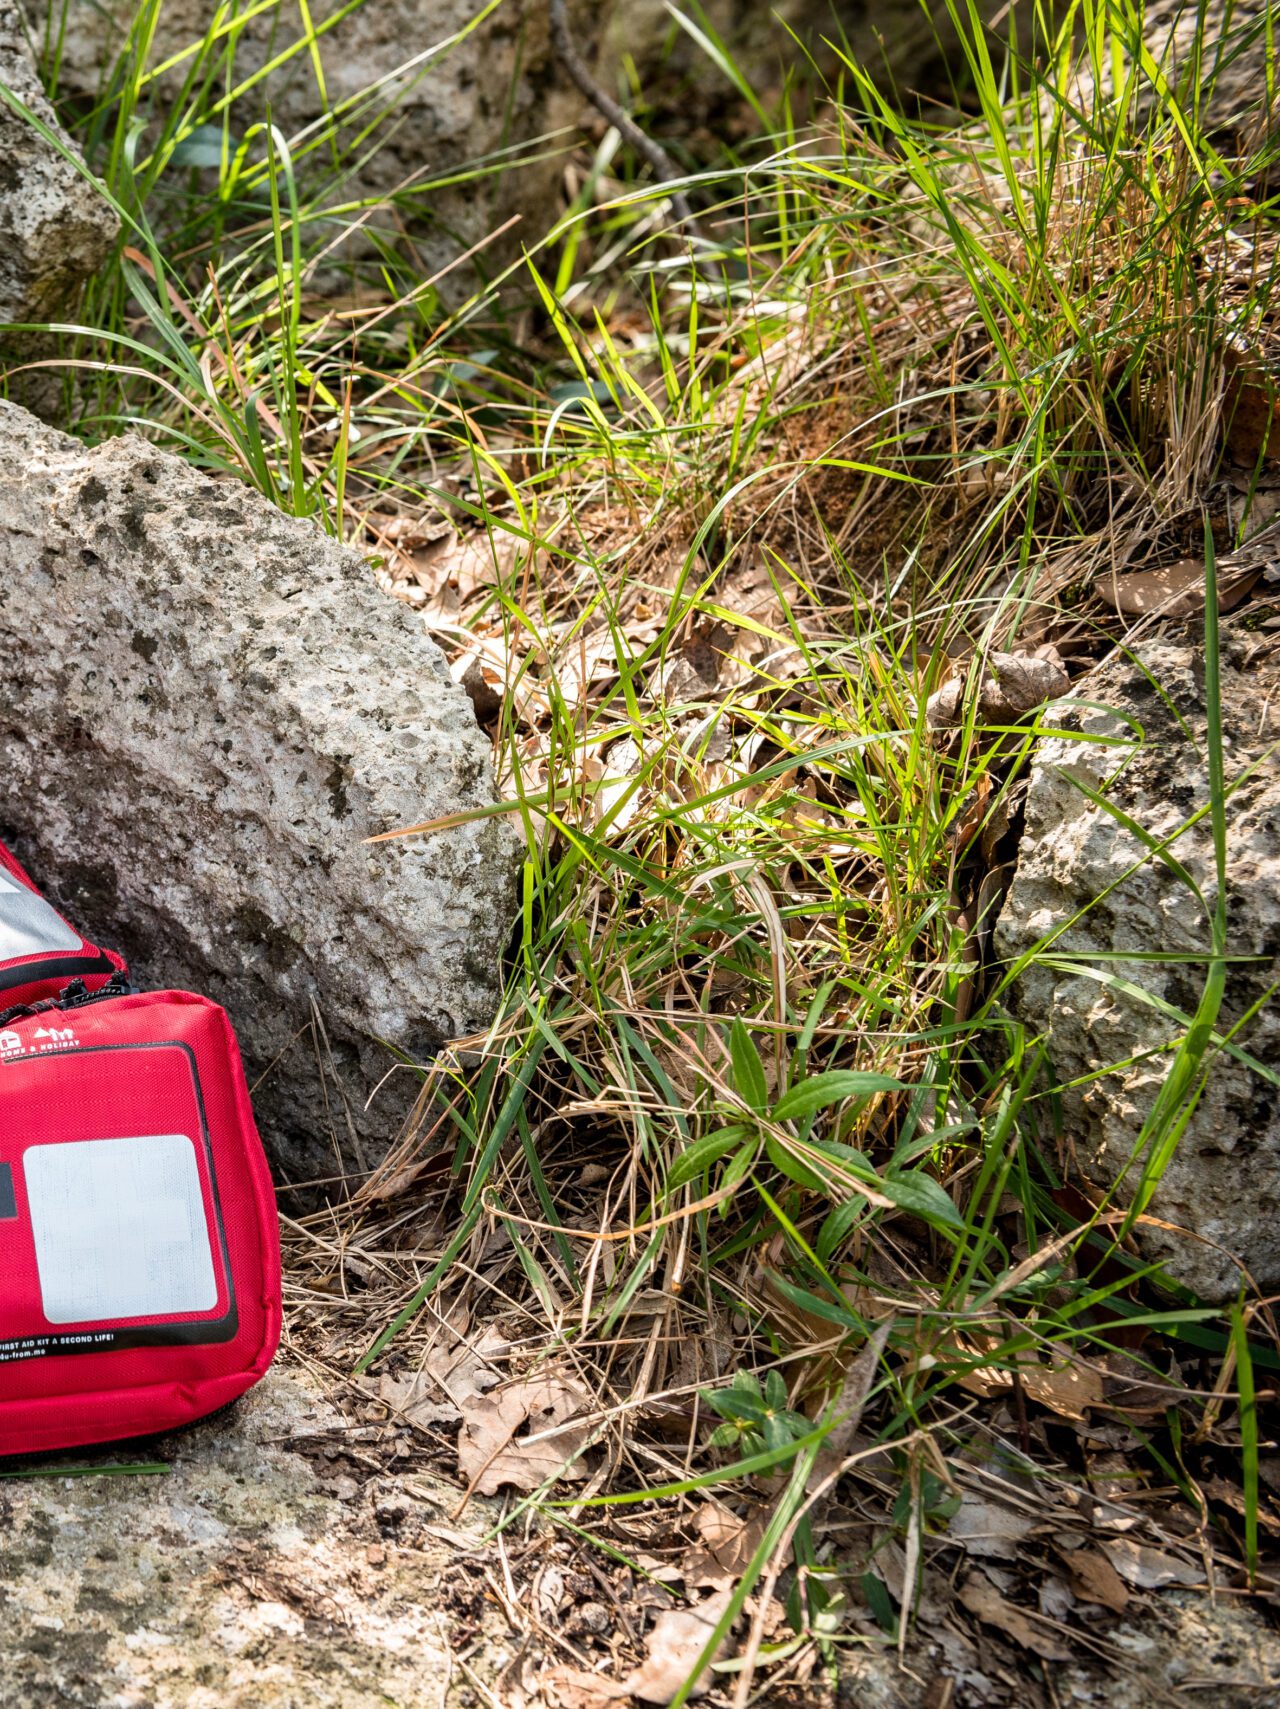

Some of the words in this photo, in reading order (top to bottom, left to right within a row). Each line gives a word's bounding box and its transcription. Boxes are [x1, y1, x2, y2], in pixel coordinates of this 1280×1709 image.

[0, 1047, 26, 1059] HOME
[40, 1040, 80, 1051] HOLIDAY
[21, 1340, 35, 1348] AID
[37, 1338, 50, 1346] KIT
[52, 1337, 58, 1345] A
[60, 1336, 93, 1344] SECOND
[94, 1333, 114, 1342] LIFE!
